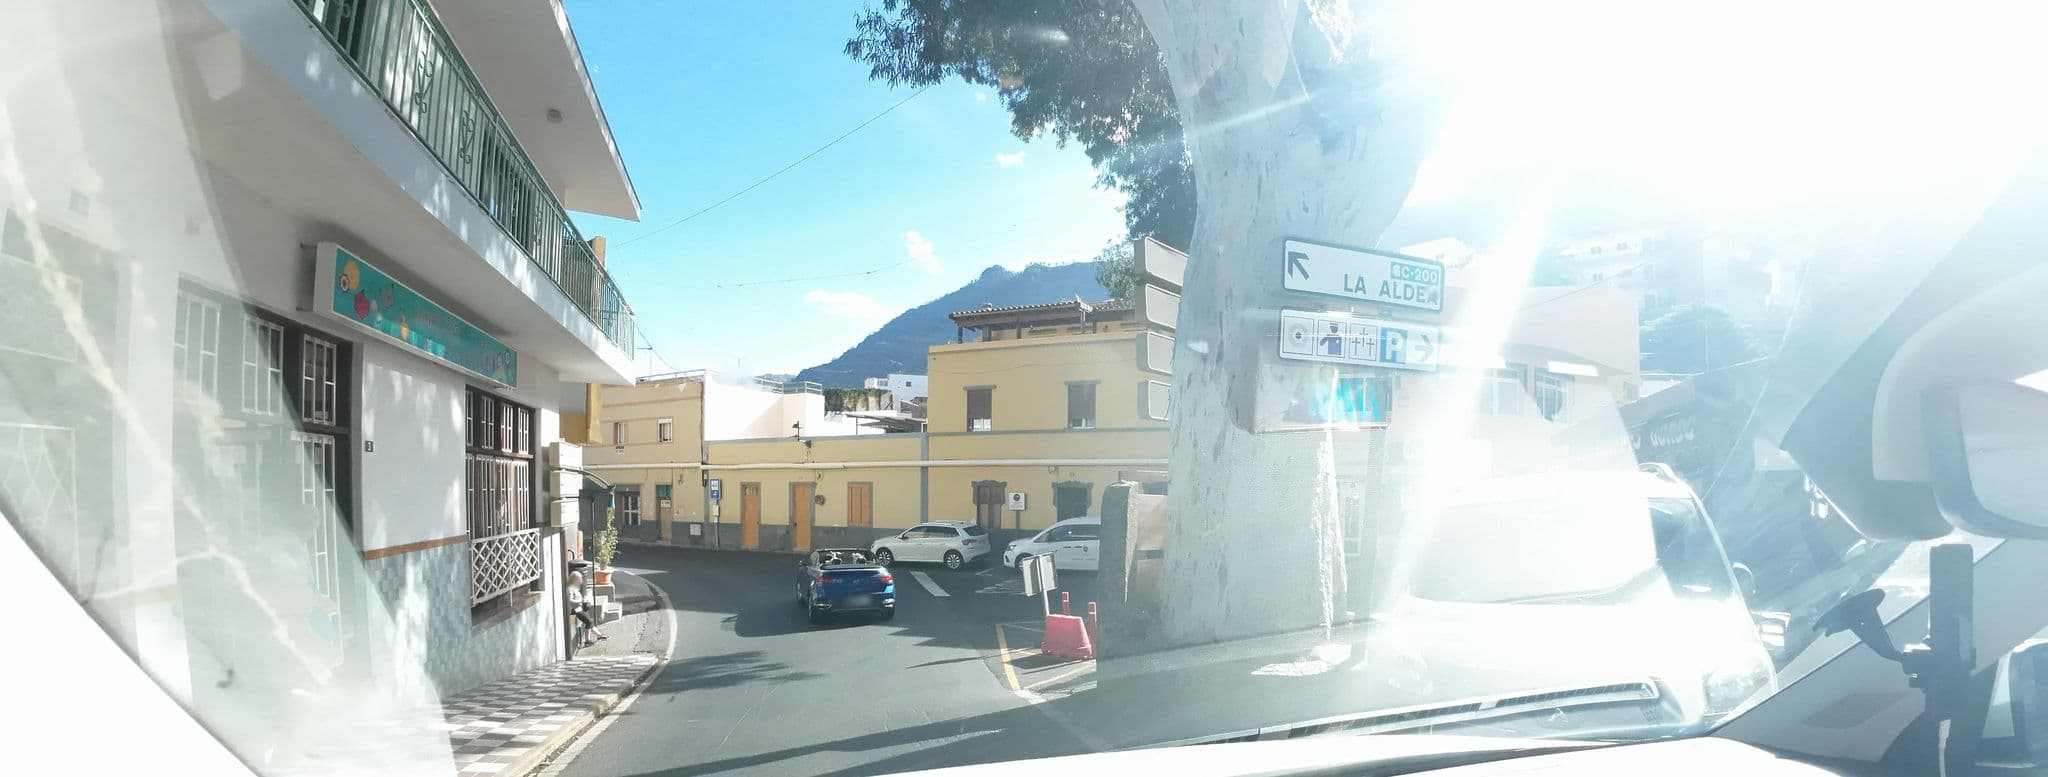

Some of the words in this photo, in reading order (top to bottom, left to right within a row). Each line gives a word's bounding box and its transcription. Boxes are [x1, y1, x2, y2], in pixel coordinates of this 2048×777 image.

[1343, 273, 1367, 295] LA
[1378, 279, 1439, 306] ALDEA
[1385, 330, 1401, 363] P
